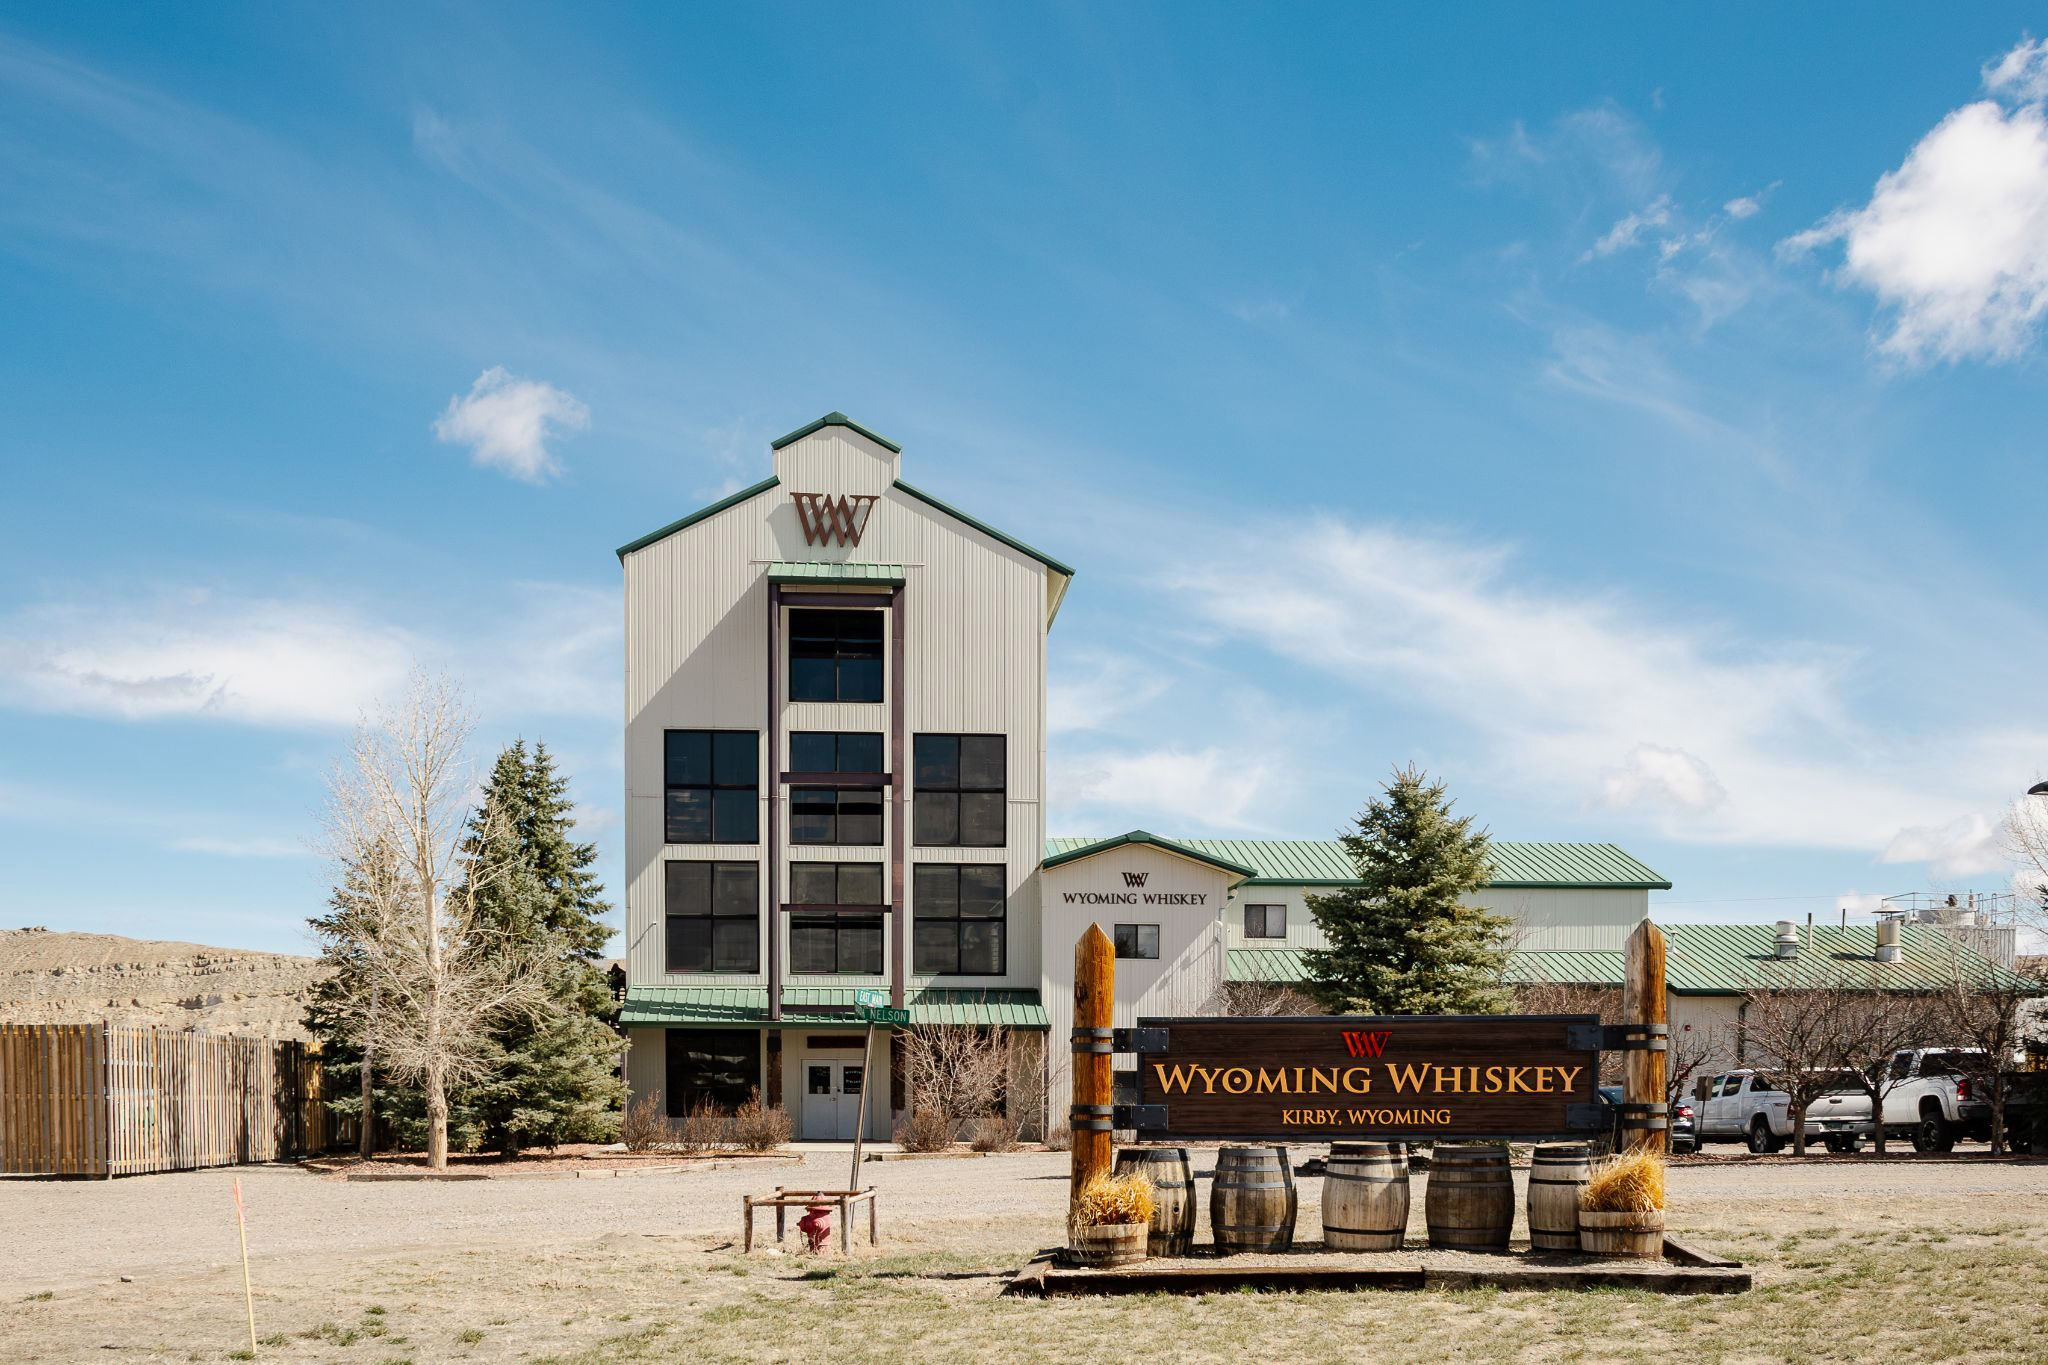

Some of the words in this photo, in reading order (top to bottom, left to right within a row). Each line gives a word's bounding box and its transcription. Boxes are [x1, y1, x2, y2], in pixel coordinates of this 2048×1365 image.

[1063, 893, 1138, 905] WYOMING
[1142, 893, 1207, 905] WHISKEY
[859, 990, 870, 1003] EAST
[870, 1009, 907, 1022] NELSON
[1153, 1064, 1373, 1094] WYOMING
[1385, 1063, 1583, 1094] WHISKEY
[1282, 1109, 1342, 1126] KIRBY,
[1347, 1109, 1451, 1125] WYOMING
